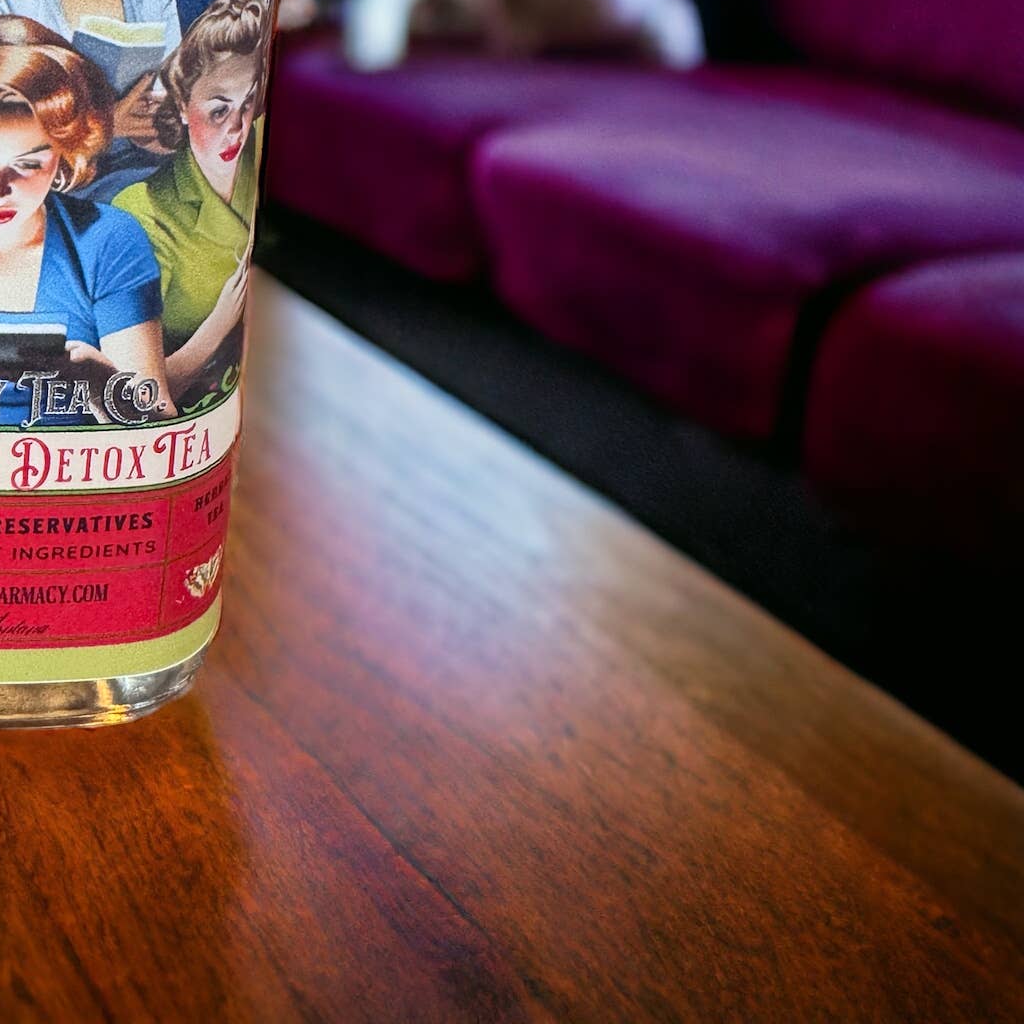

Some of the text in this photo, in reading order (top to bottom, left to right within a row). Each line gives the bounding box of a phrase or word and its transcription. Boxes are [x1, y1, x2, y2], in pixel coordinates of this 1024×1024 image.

[16, 370, 91, 428] TEA
[103, 371, 167, 424] CO.
[10, 437, 147, 492] DETOX
[152, 422, 212, 480] TEA
[11, 539, 158, 561] INGREDIENTS
